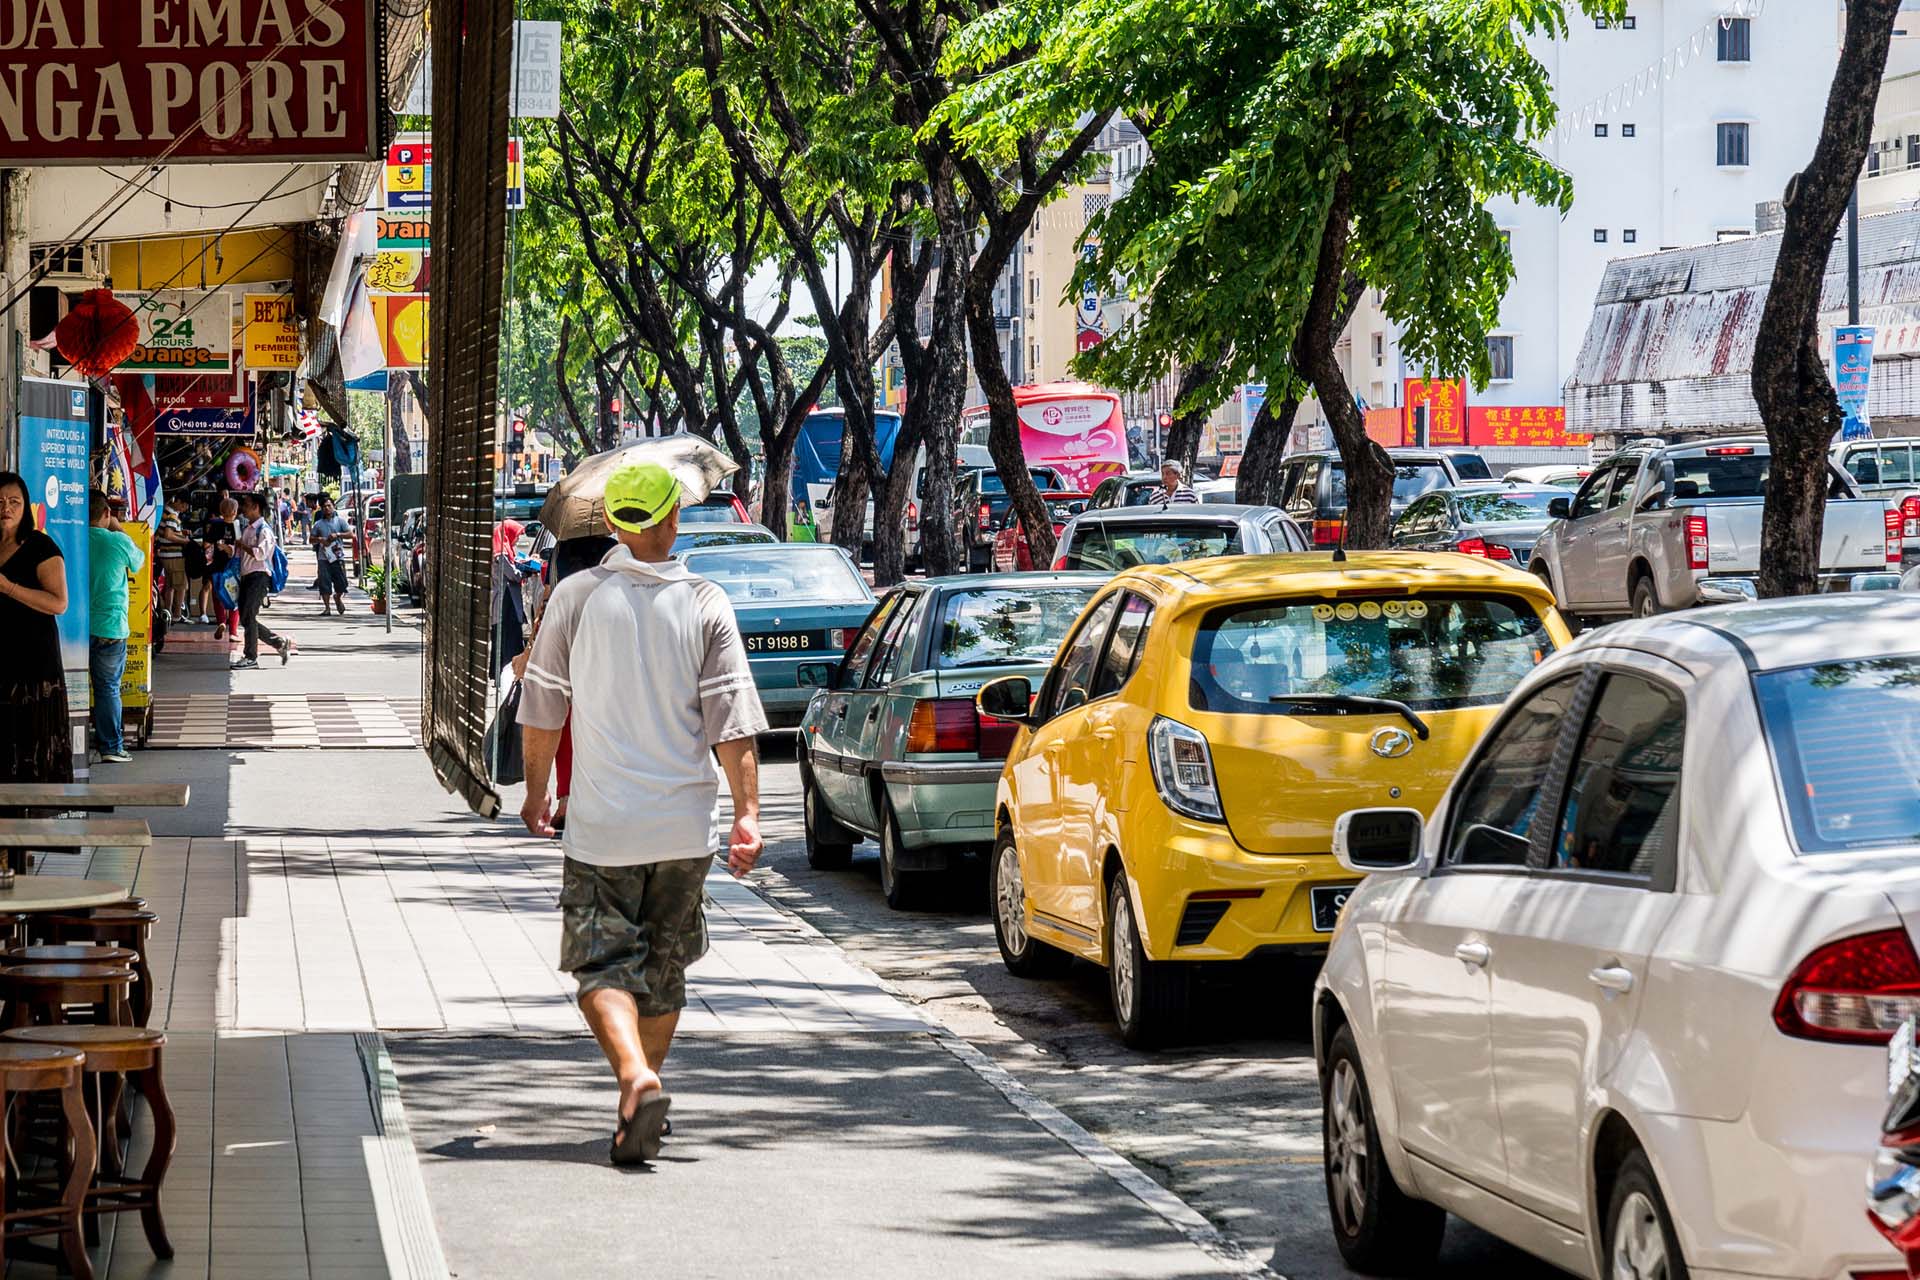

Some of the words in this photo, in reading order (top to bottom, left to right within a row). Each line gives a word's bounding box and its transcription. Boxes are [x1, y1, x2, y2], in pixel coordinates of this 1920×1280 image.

[138, 0, 346, 48] EMAS
[400, 150, 412, 162] P
[152, 318, 195, 338] 24
[152, 338, 193, 347] HOURS
[129, 343, 212, 367] Orange
[272, 353, 294, 363] TEL:
[748, 637, 763, 650] ST
[767, 636, 798, 649] 9198
[801, 635, 809, 648] B
